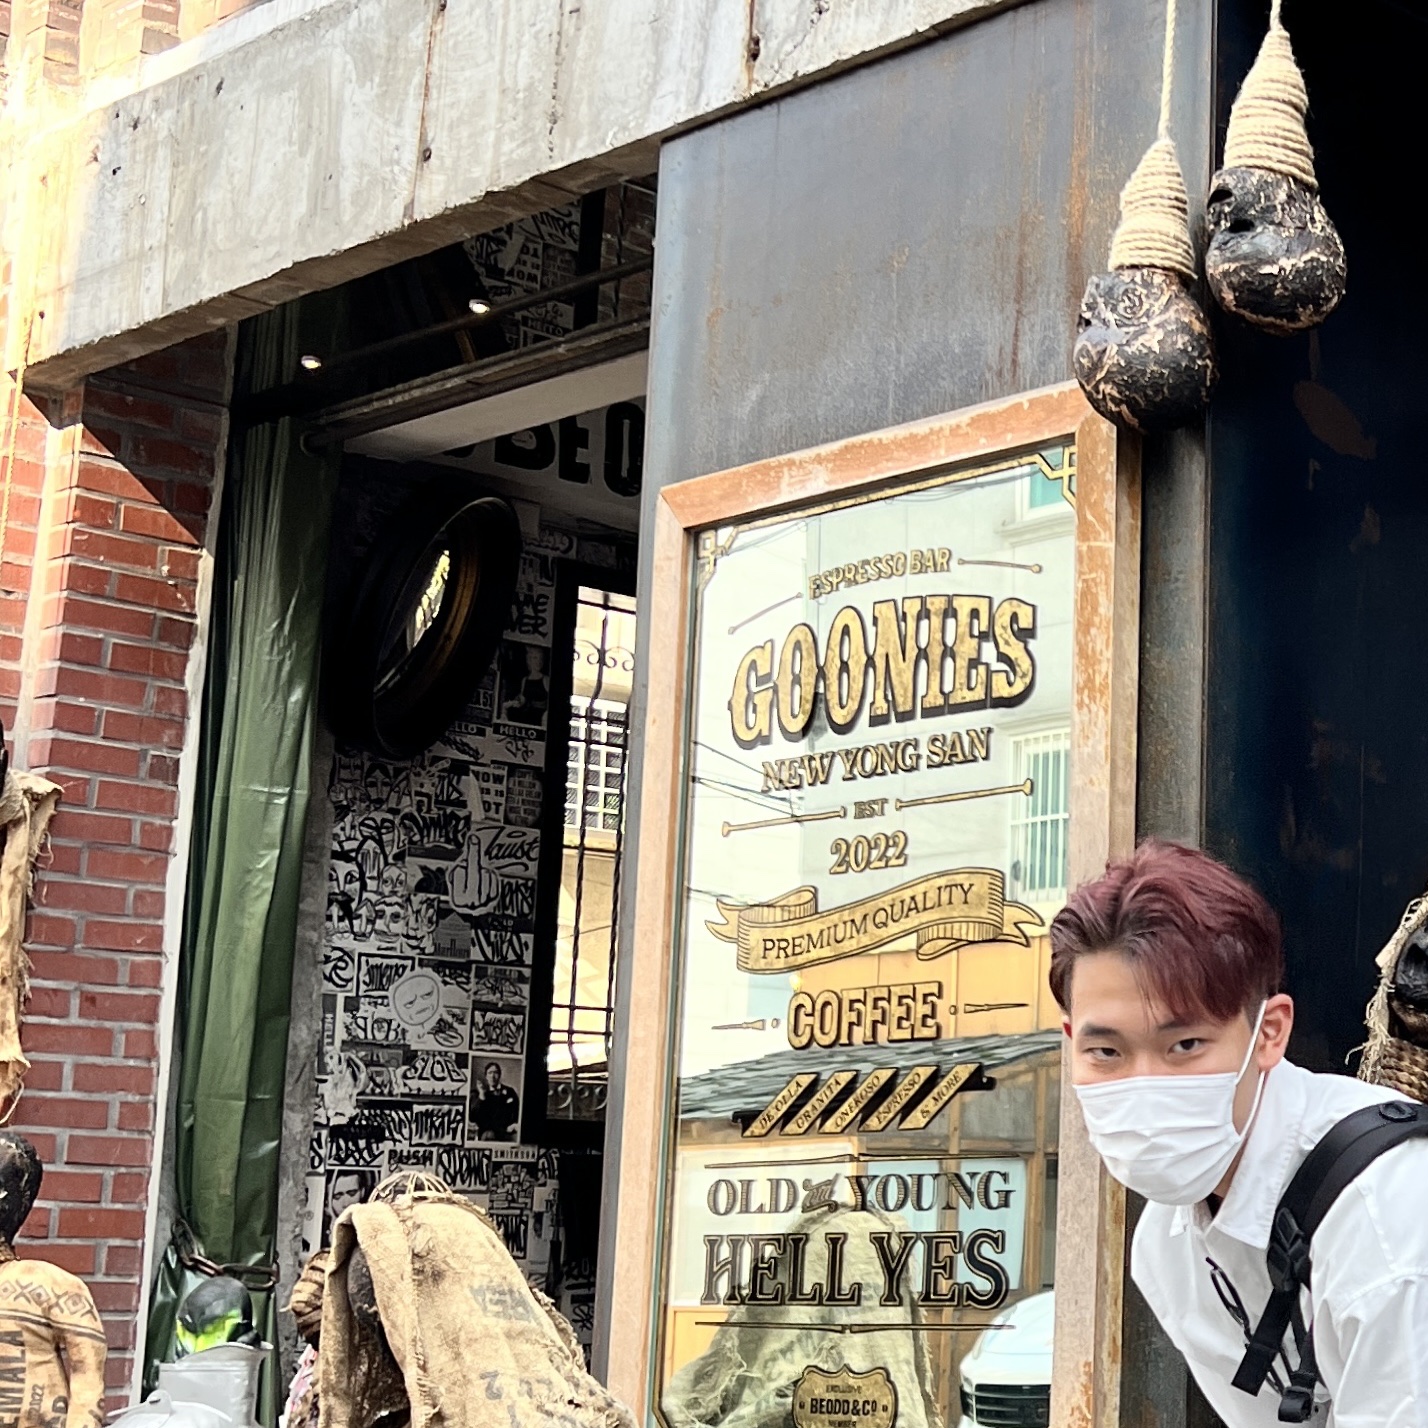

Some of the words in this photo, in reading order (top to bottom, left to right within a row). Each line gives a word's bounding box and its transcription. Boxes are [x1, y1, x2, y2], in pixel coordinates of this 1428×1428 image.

[808, 552, 905, 600] ESPRESSO
[909, 547, 952, 574] BAR
[728, 594, 1037, 750] GOONIES
[499, 725, 538, 740] HELLO
[761, 748, 836, 793] NEW
[837, 740, 921, 782] YONG
[927, 726, 993, 768] SAN
[853, 798, 888, 819] EST
[829, 829, 909, 874] 2022
[761, 914, 870, 960] PREMIUM
[871, 882, 975, 929] QUALITY
[787, 981, 943, 1049] COFFEE
[774, 1078, 803, 1112] OLLA
[795, 1076, 843, 1130] GRANITA
[876, 1071, 922, 1125] ESPRESSO
[932, 1070, 963, 1107] MORE
[706, 1177, 799, 1217] OLD
[845, 1170, 1016, 1213] YOUNG
[700, 1232, 863, 1308] HELL
[869, 1228, 1010, 1310] YES
